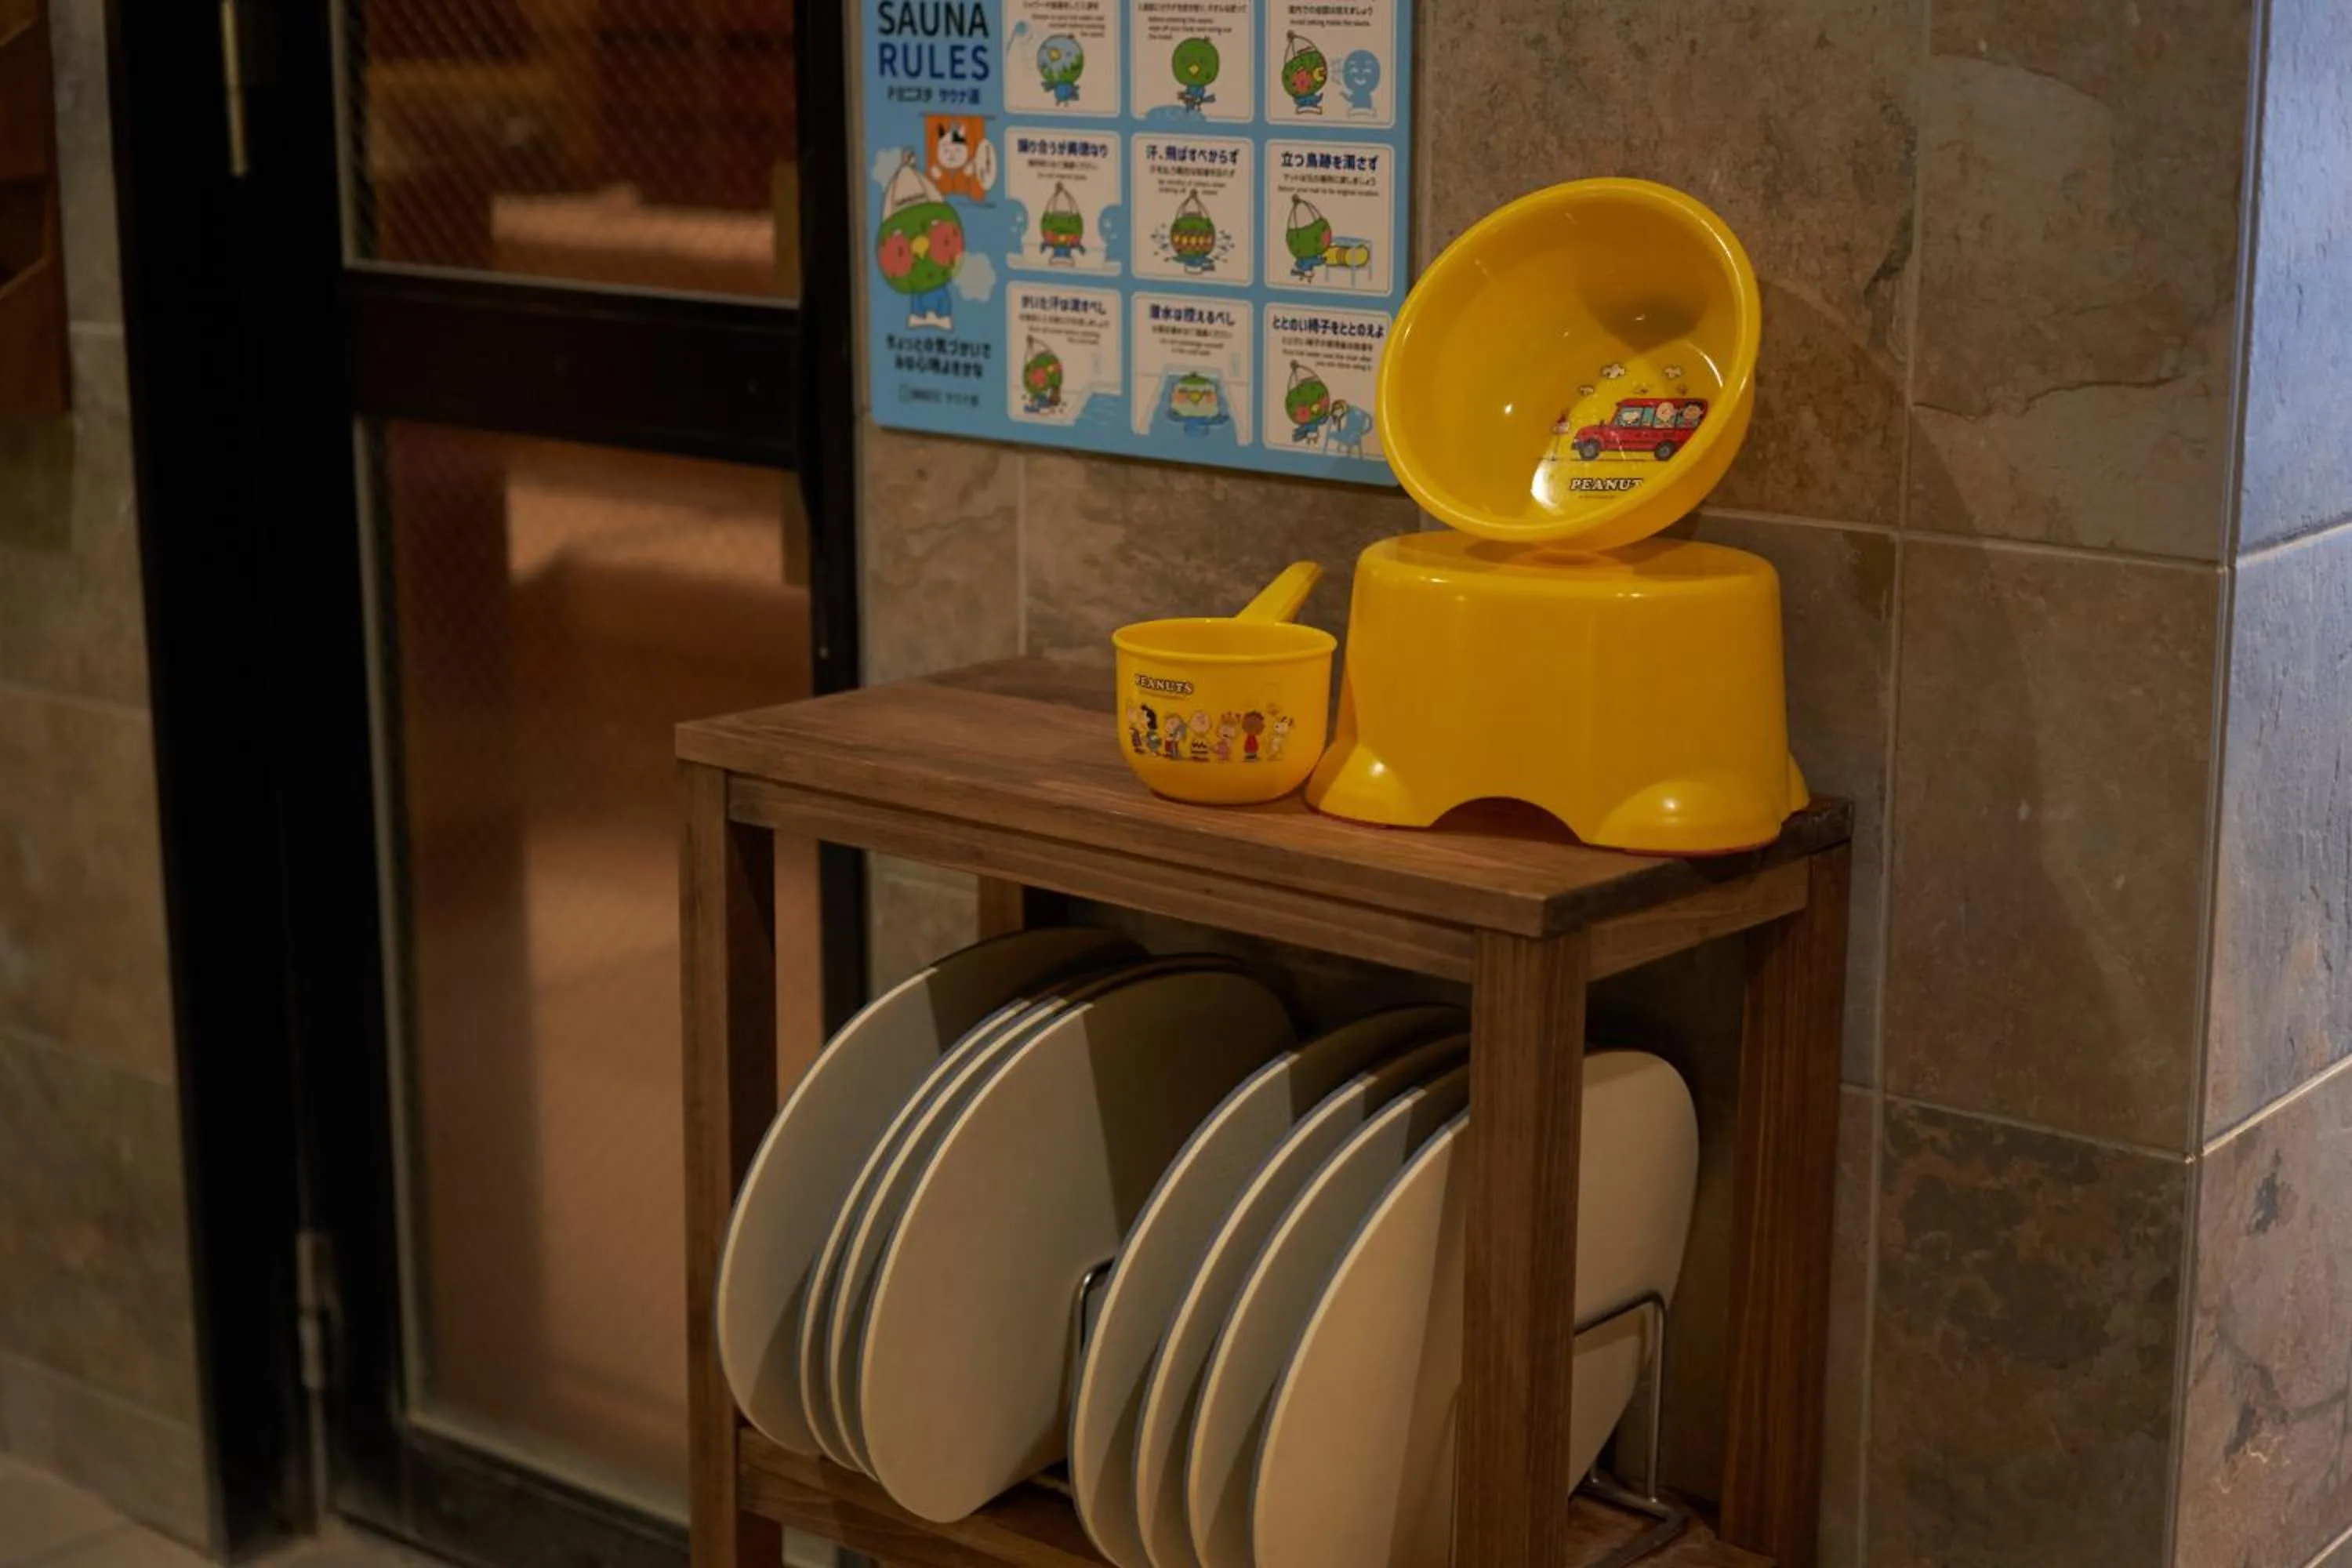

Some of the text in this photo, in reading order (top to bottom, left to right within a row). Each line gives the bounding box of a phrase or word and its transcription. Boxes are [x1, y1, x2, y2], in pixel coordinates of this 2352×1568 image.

[877, 0, 989, 38] SAUNA
[877, 42, 990, 81] RULES
[1134, 673, 1194, 695] PEANUTS
